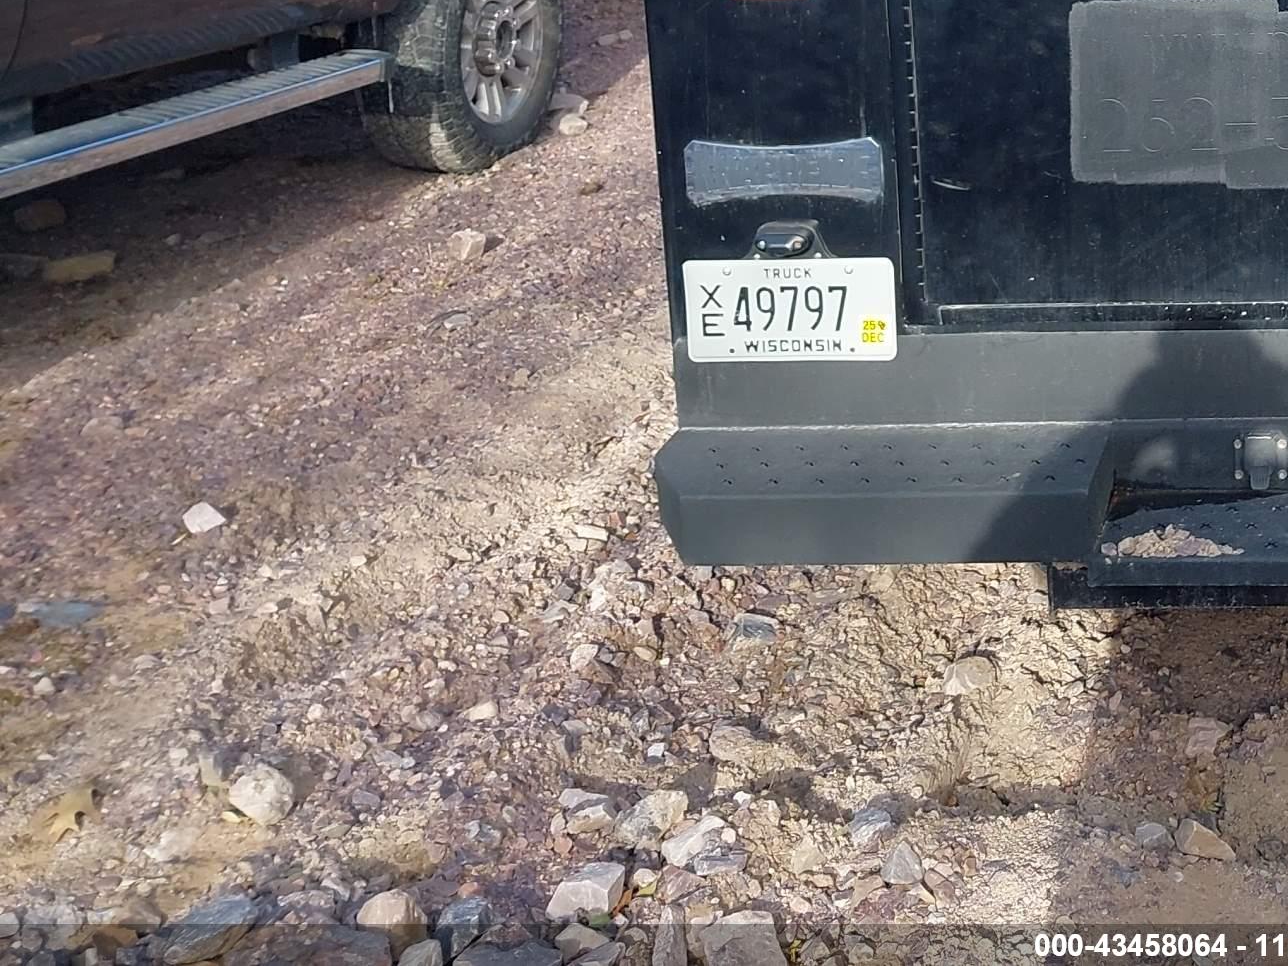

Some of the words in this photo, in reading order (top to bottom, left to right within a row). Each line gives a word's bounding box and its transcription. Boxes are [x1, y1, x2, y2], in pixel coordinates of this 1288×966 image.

[763, 268, 812, 279] TRUCK
[733, 285, 848, 332] 49797
[861, 332, 885, 343] DEC
[744, 339, 842, 353] WISCONSIN
